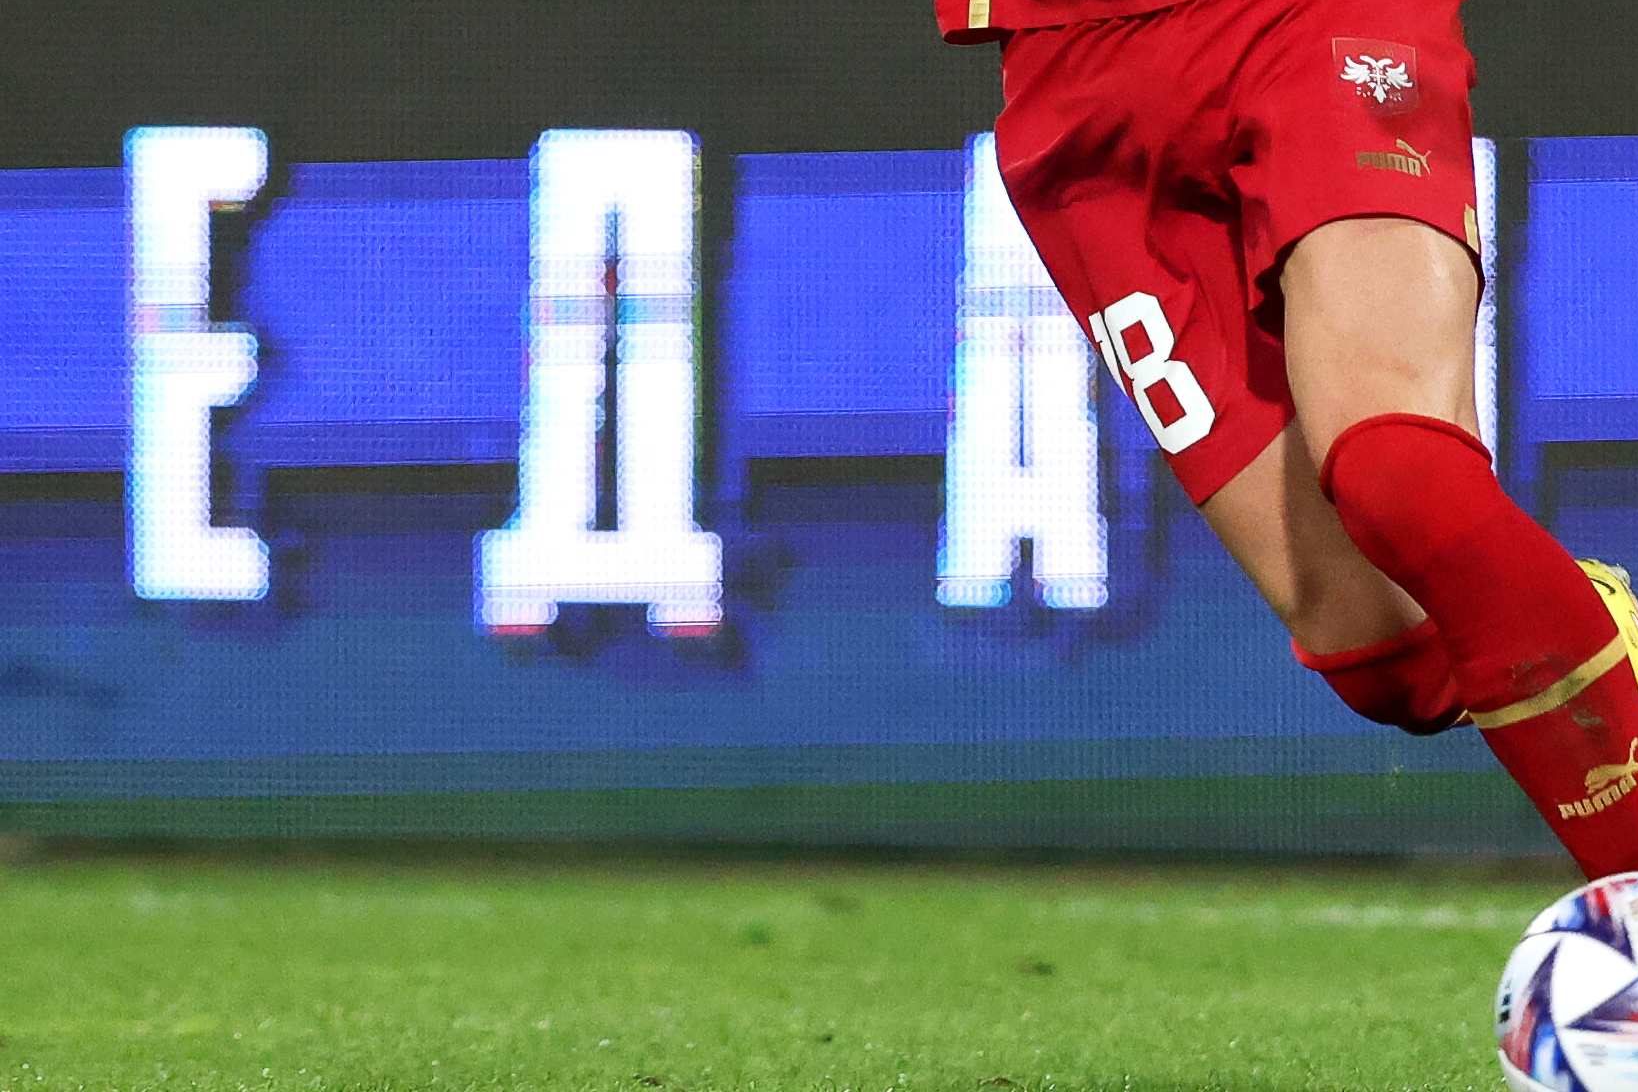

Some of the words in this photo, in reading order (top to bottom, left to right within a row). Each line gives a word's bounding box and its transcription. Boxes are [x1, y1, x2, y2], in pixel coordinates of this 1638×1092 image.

[1356, 151, 1422, 177] PUMA
[1088, 290, 1217, 455] 18
[1557, 773, 1637, 820] PUMA
